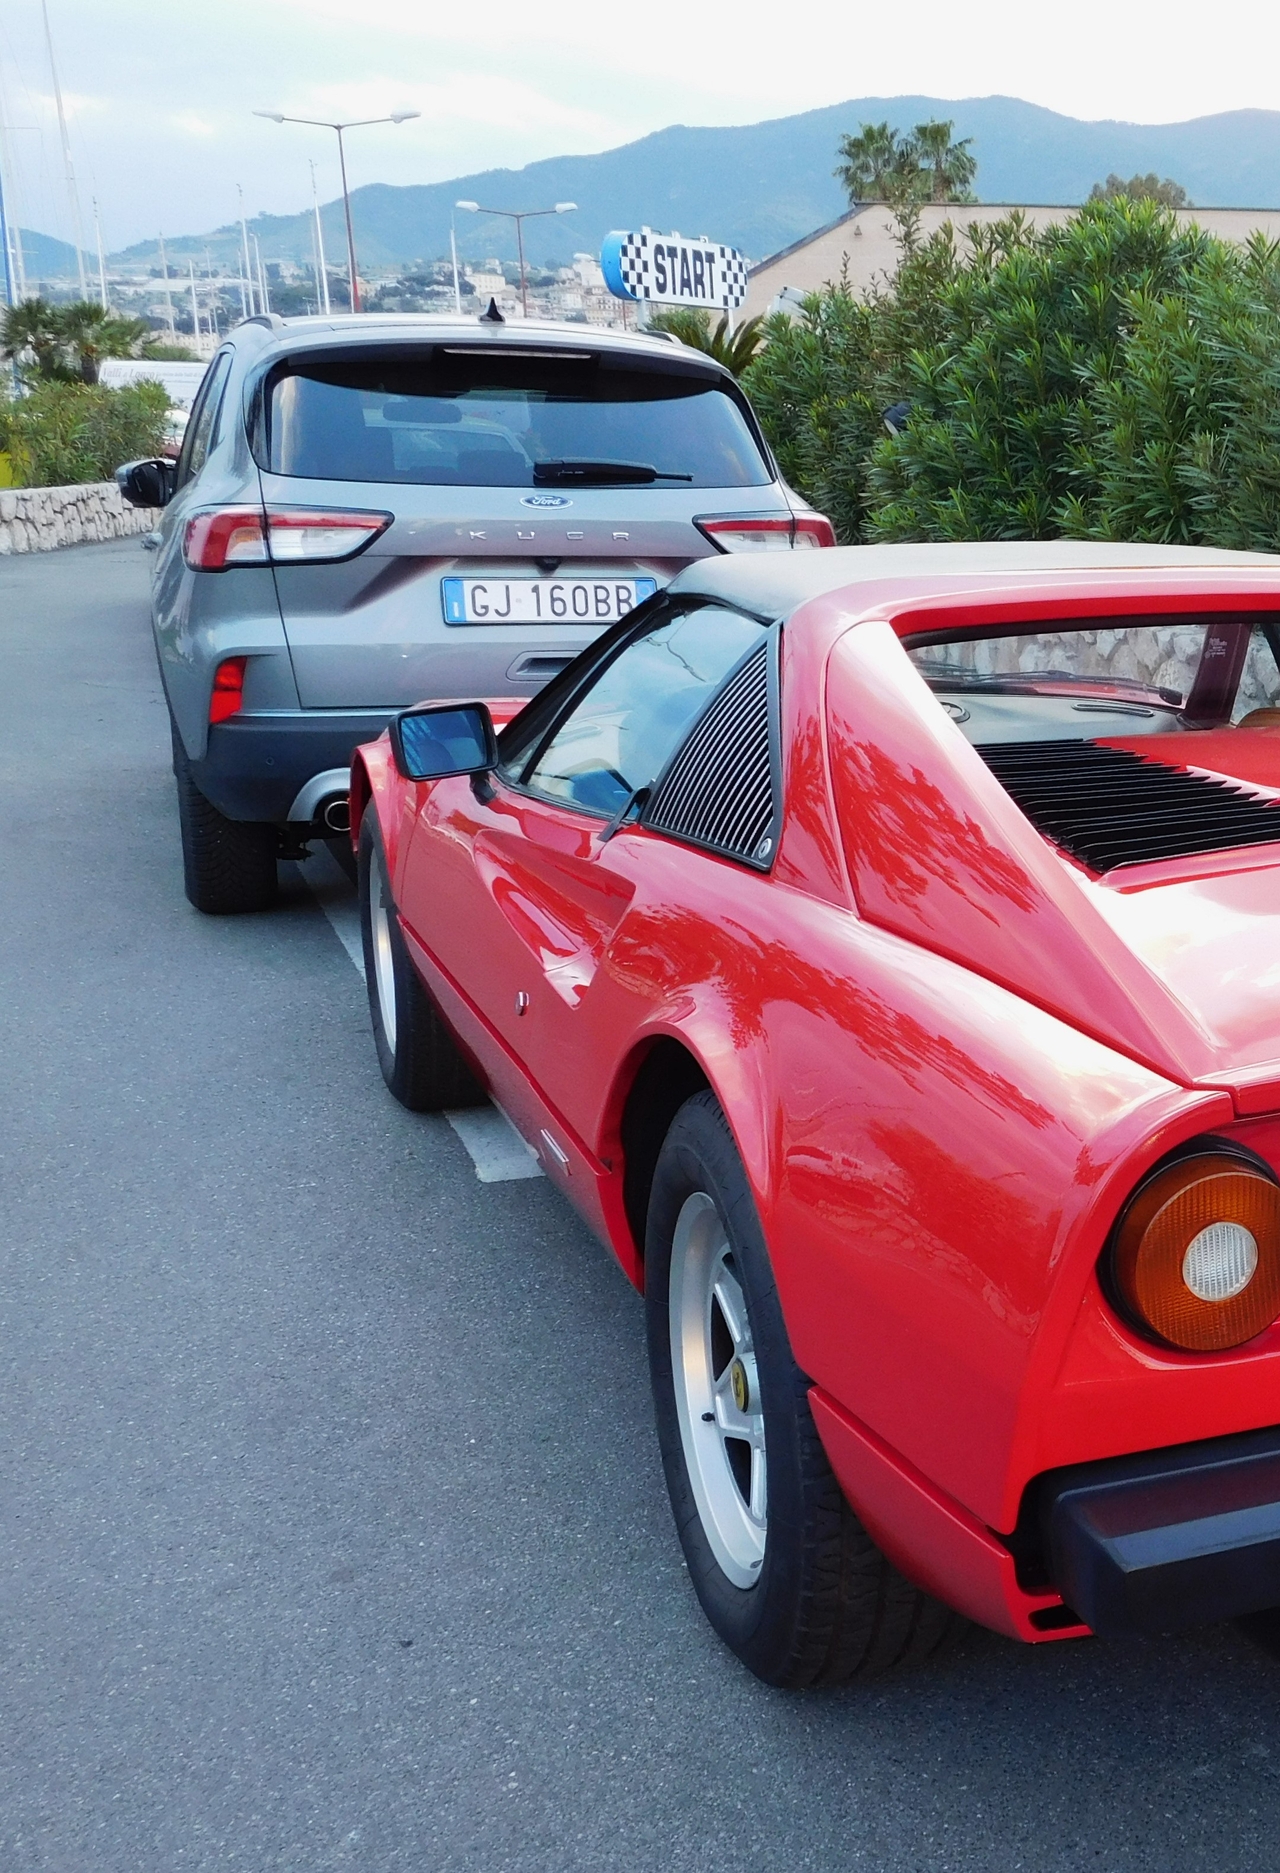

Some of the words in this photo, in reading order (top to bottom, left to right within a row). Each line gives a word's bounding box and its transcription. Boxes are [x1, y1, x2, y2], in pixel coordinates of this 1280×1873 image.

[654, 243, 715, 299] START
[532, 495, 562, 505] Ford
[469, 530, 630, 541] KUGA
[470, 584, 511, 617] GJ
[531, 584, 633, 617] 160BB
